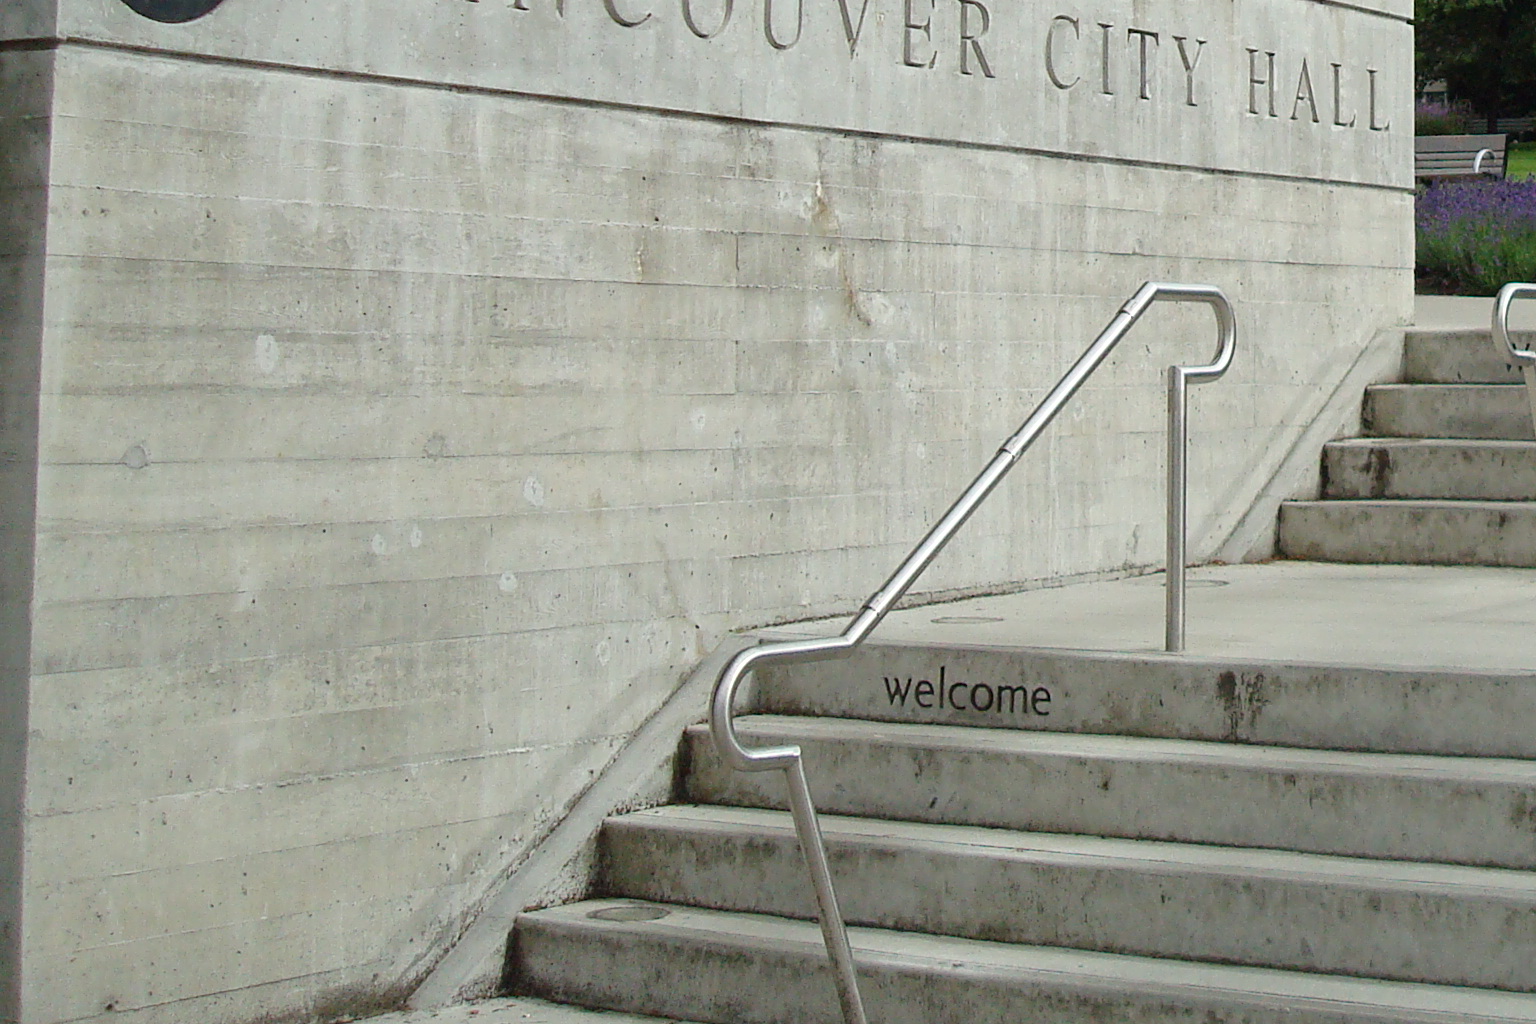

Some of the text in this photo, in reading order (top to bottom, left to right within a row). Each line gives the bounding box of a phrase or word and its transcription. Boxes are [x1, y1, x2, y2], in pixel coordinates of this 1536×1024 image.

[1045, 14, 1207, 107] CITY
[1245, 47, 1391, 132] HALL
[883, 666, 1052, 716] welcome
